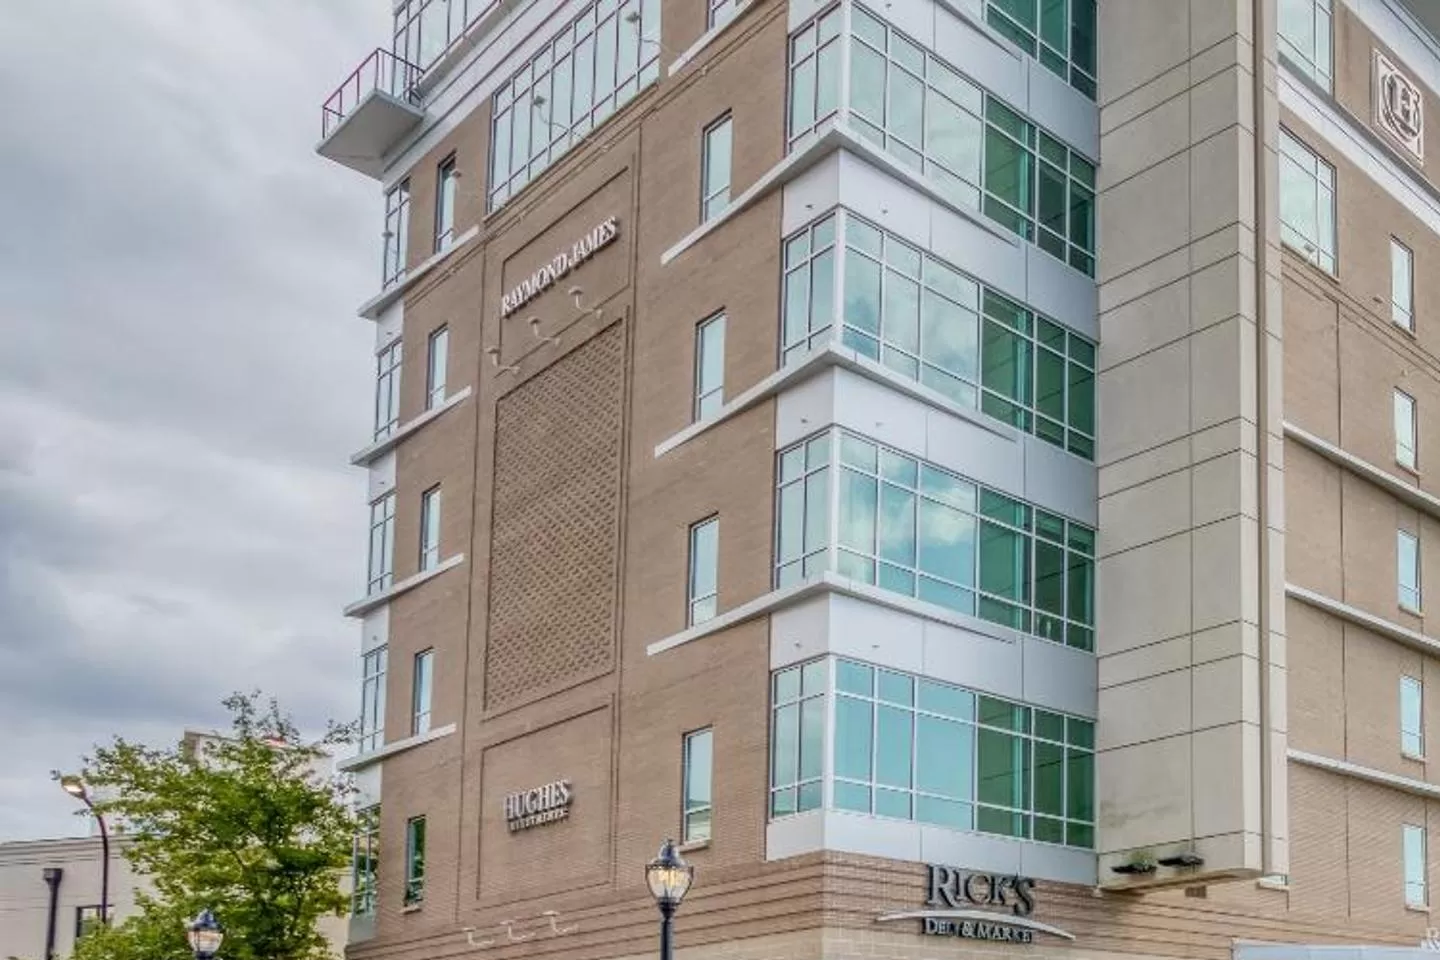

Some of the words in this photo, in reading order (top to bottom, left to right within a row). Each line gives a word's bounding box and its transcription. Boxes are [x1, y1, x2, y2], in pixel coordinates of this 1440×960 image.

[502, 253, 569, 317] RAYMOND
[567, 216, 617, 268] JAMES
[504, 779, 571, 820] HUGHES
[926, 864, 1036, 917] RICK'S
